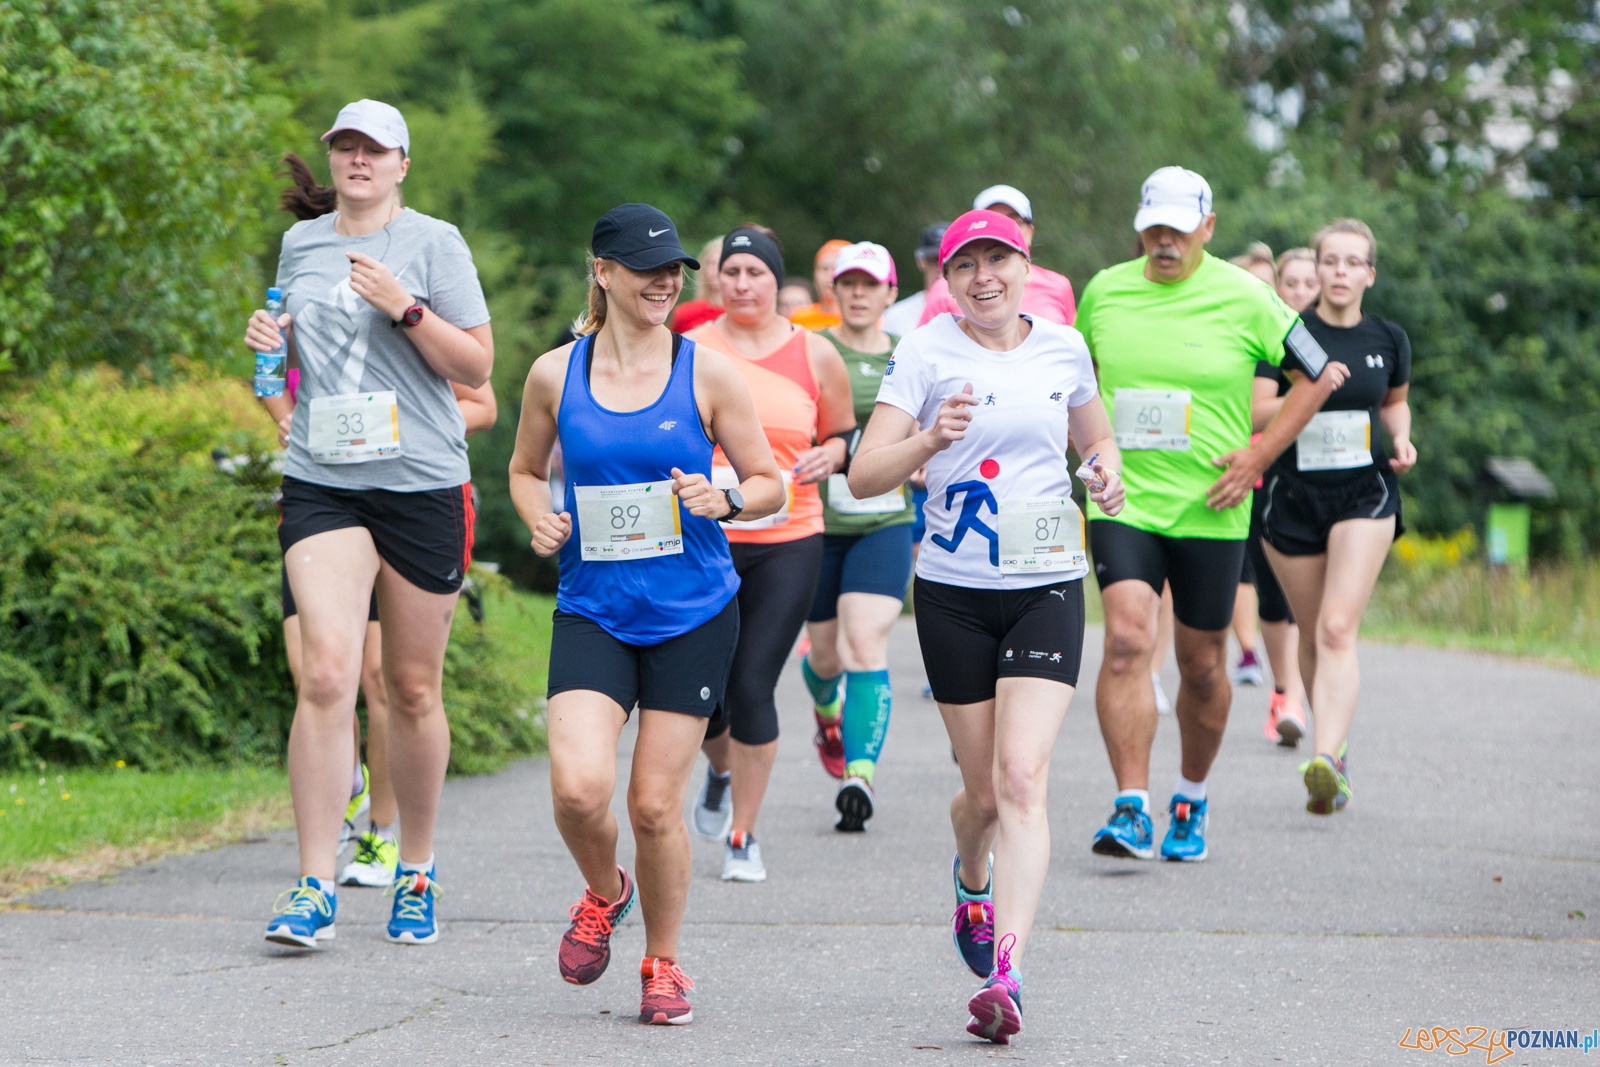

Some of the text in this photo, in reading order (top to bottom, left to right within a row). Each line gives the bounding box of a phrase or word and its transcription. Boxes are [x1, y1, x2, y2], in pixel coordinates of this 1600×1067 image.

[1049, 391, 1062, 402] 4F
[337, 412, 364, 435] 33
[1138, 405, 1162, 425] 60
[658, 420, 677, 431] 4F
[1323, 426, 1346, 444] 86
[610, 505, 640, 529] 89
[1035, 516, 1061, 541] 87
